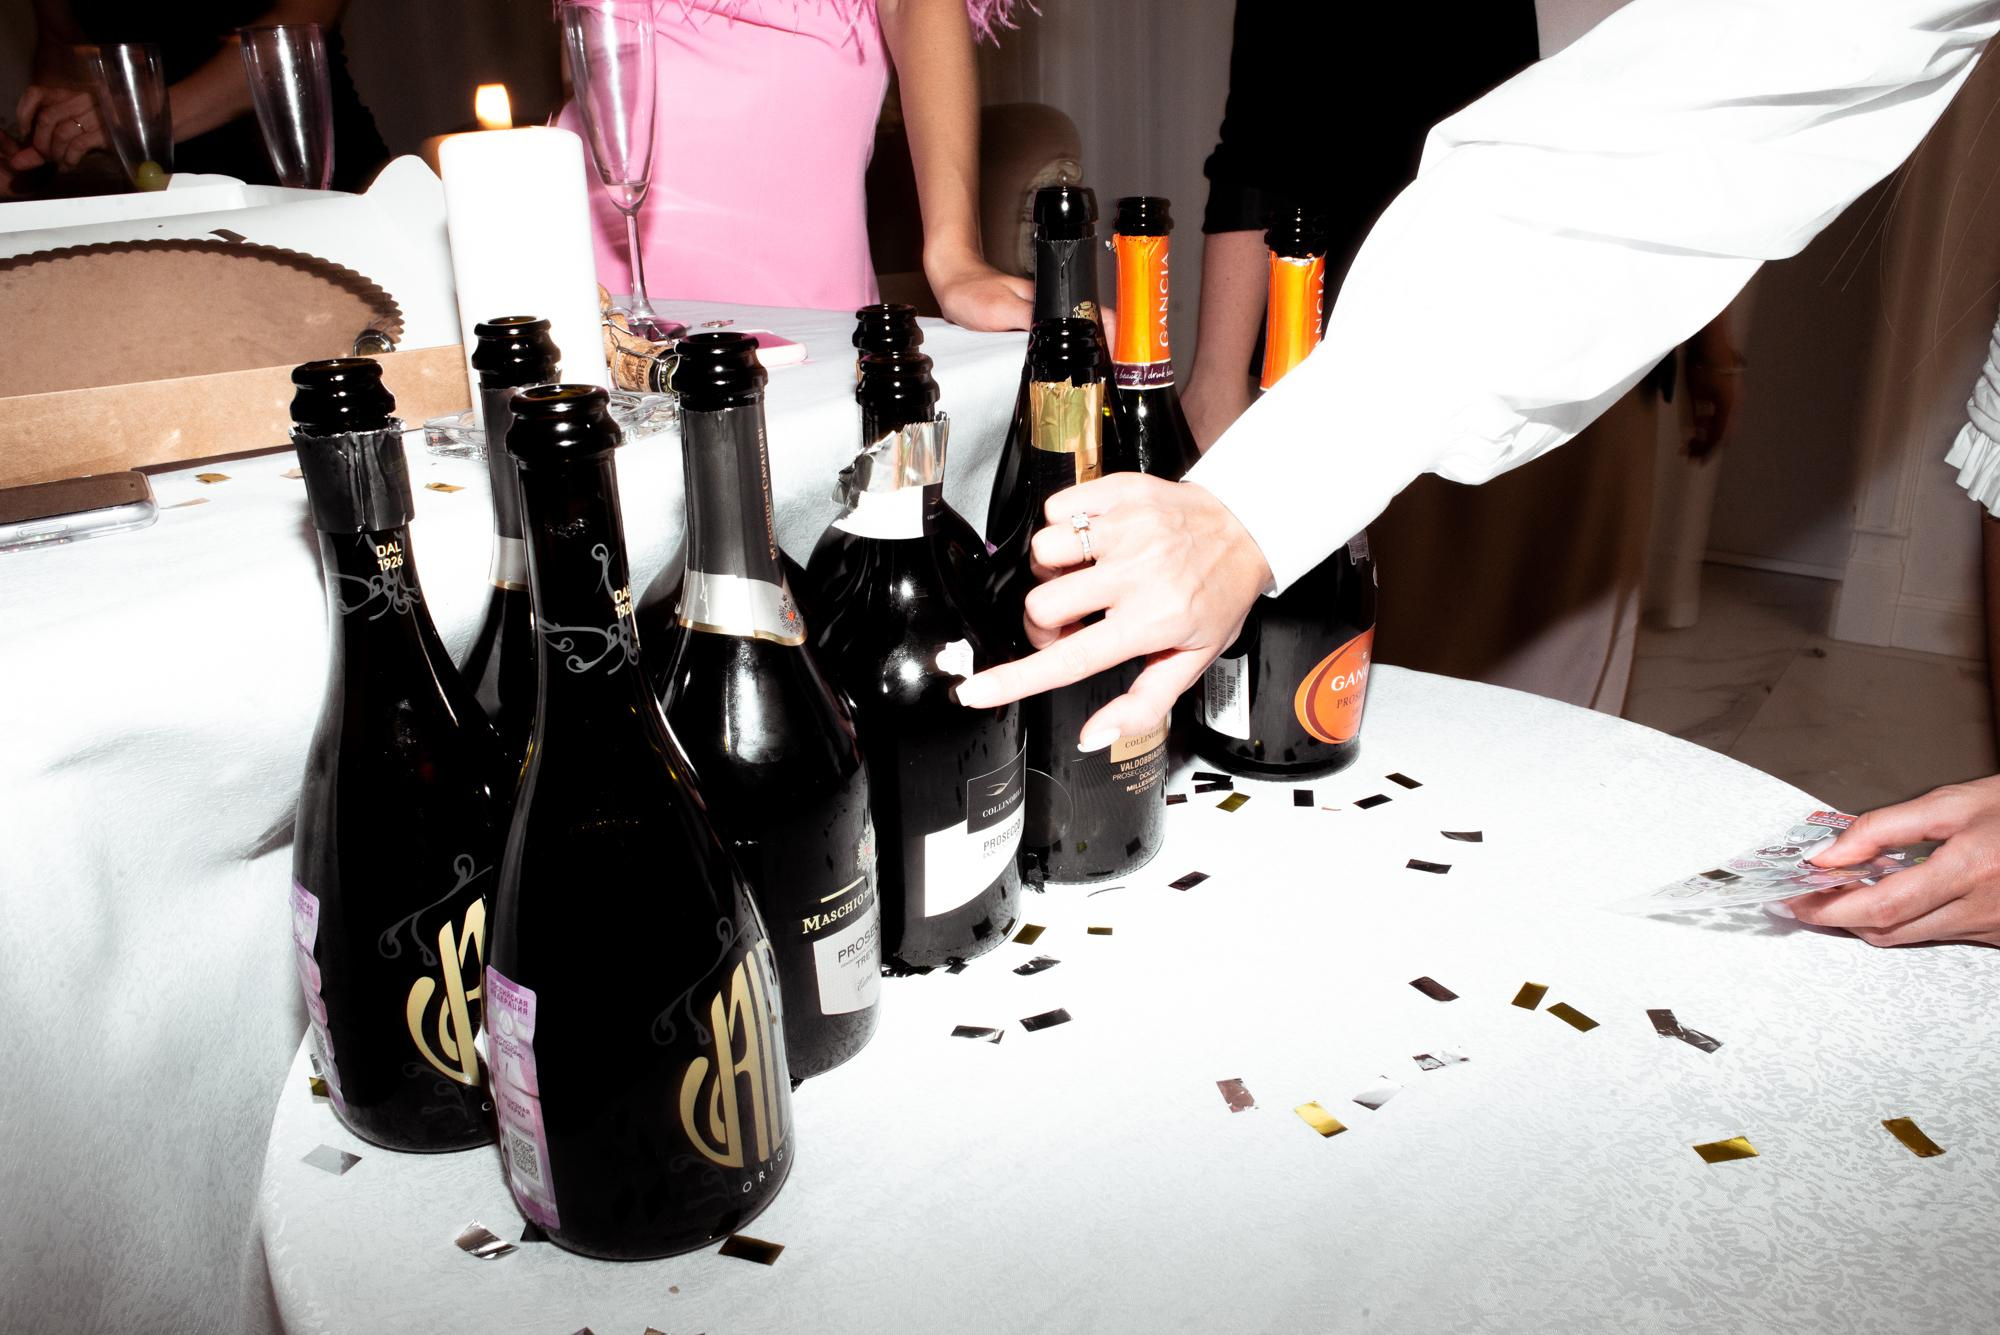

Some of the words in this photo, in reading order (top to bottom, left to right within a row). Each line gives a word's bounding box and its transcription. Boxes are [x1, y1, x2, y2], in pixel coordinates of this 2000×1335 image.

[1159, 252, 1169, 347] GANCIA
[376, 541, 402, 558] DAL
[377, 554, 404, 571] 1926
[802, 893, 864, 935] MASCHIO
